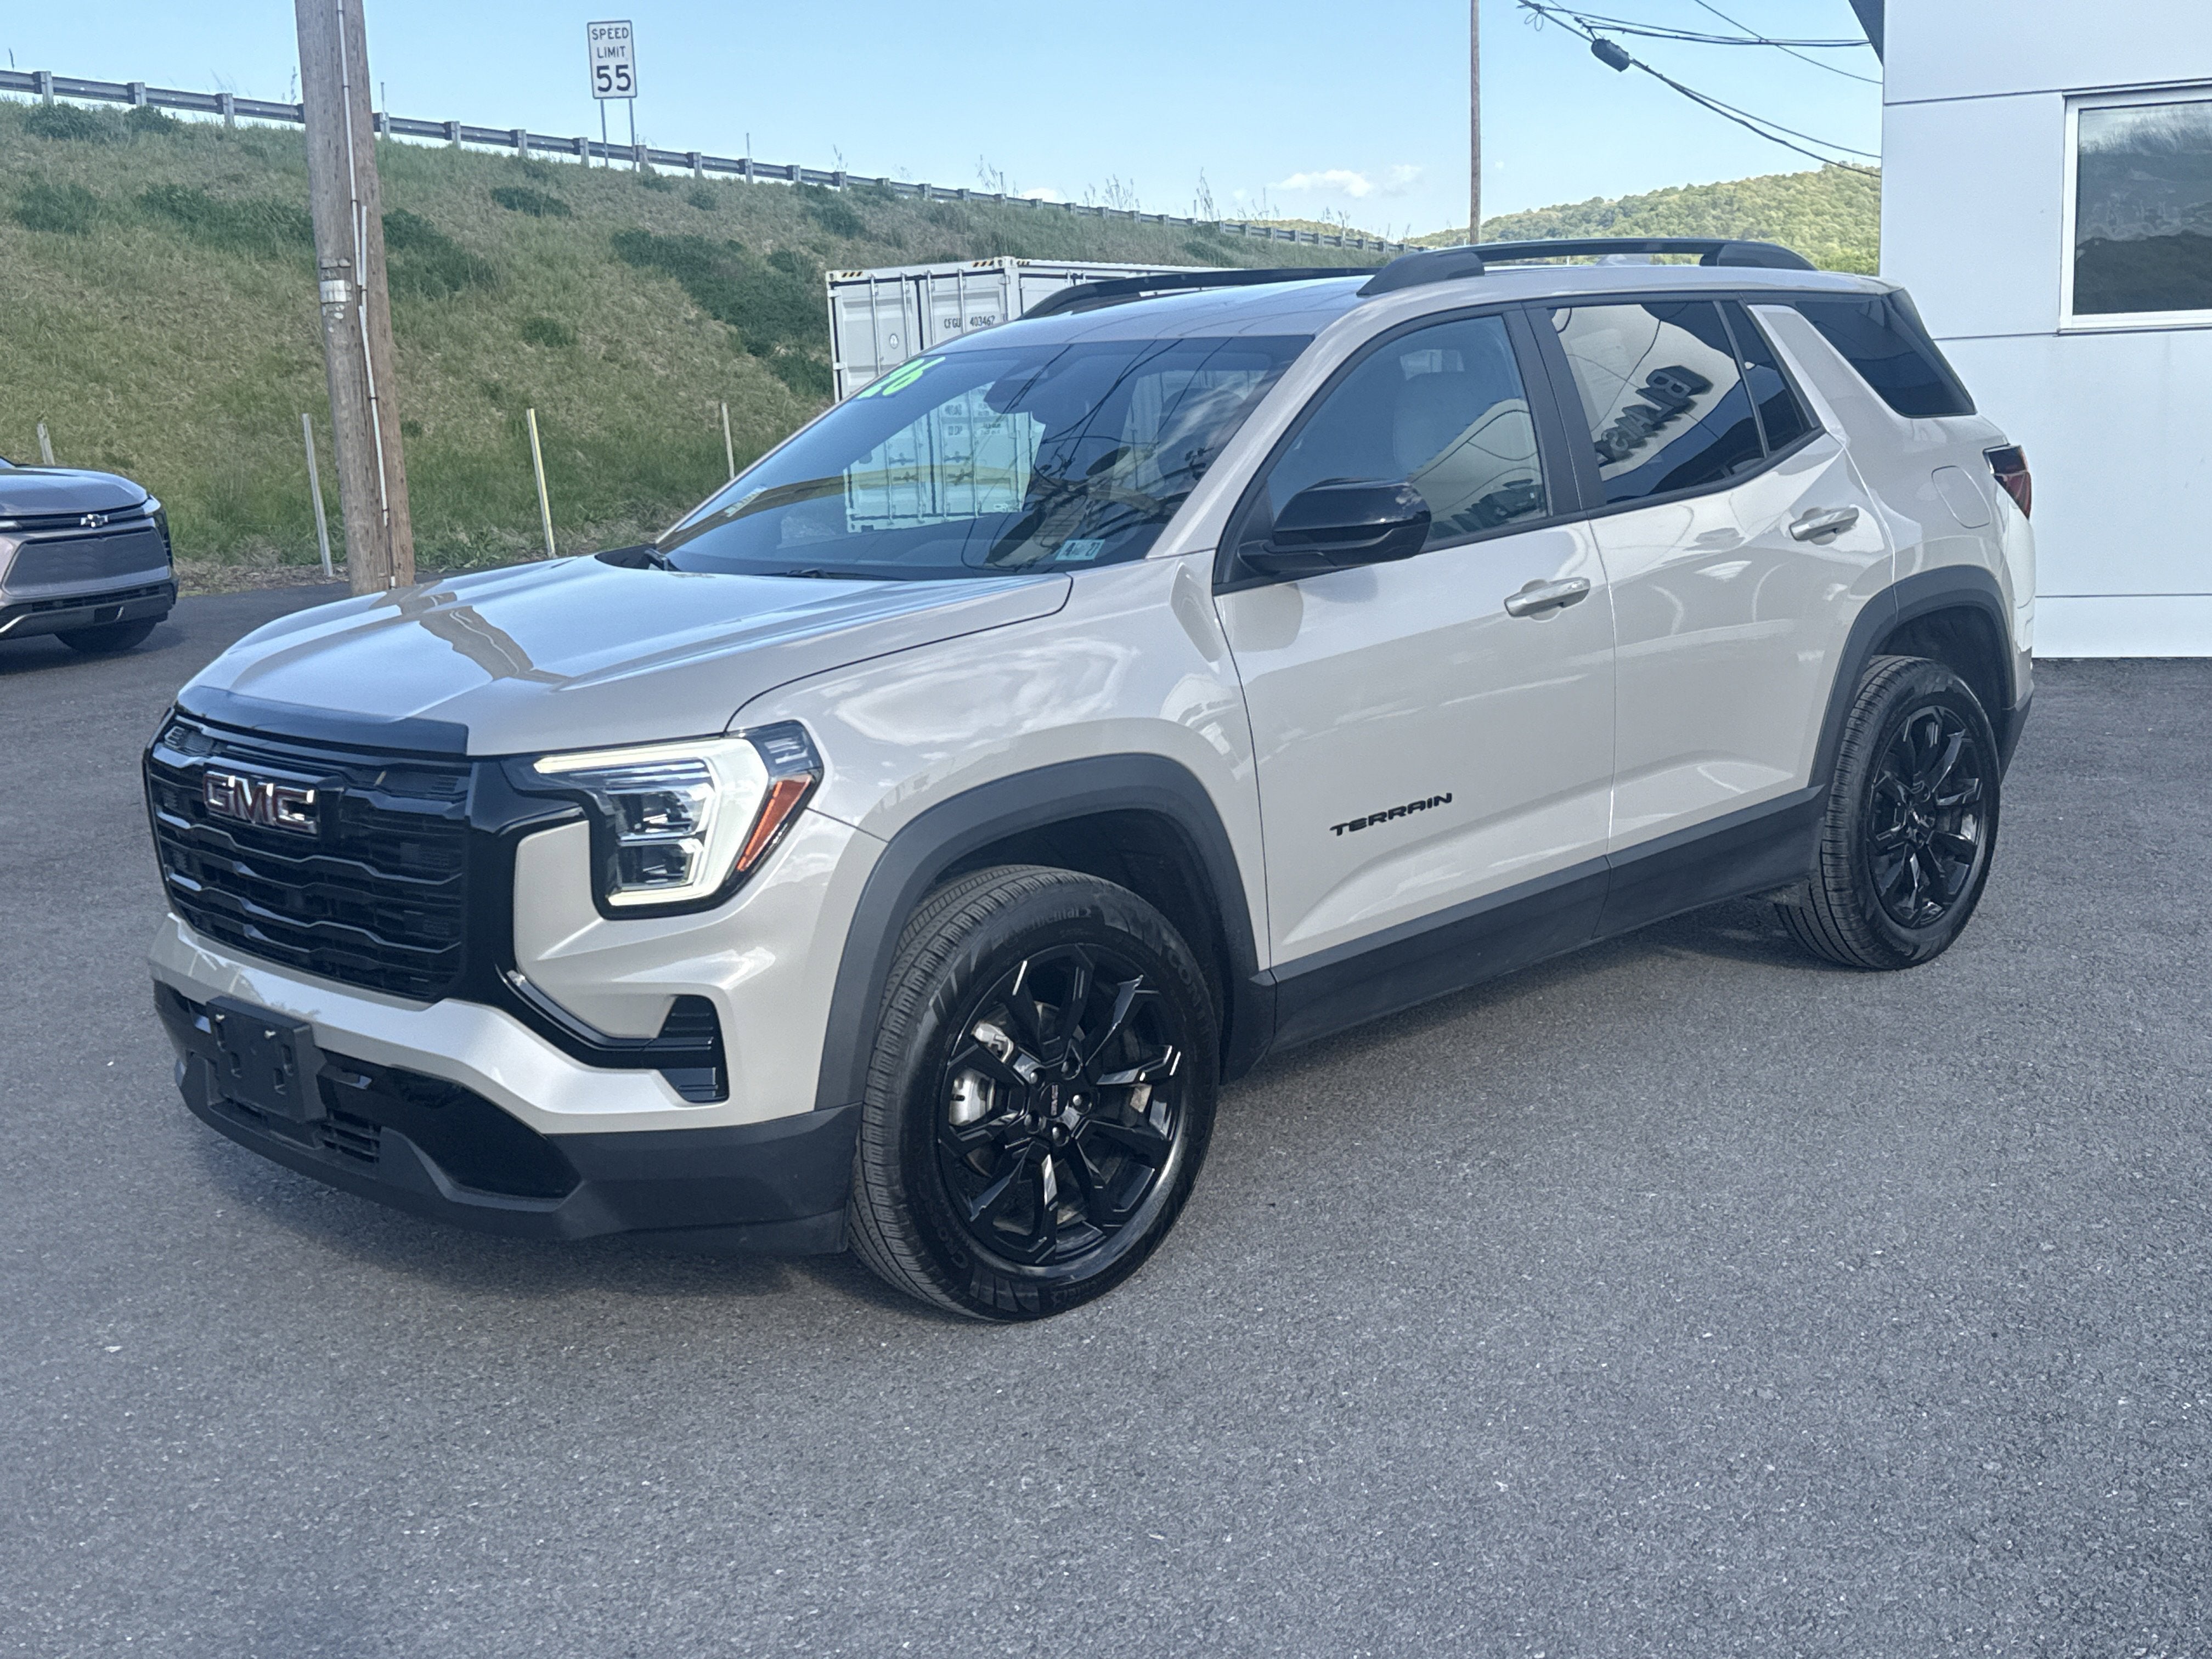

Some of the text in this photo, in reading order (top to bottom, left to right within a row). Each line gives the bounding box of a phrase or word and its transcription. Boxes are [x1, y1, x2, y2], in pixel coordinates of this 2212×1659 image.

[591, 27, 629, 40] SPEED
[597, 46, 626, 58] LIMIT
[596, 64, 631, 92] 55
[944, 318, 961, 329] CFGU
[203, 770, 317, 834] GMC
[1329, 793, 1452, 836] TERRAIN
